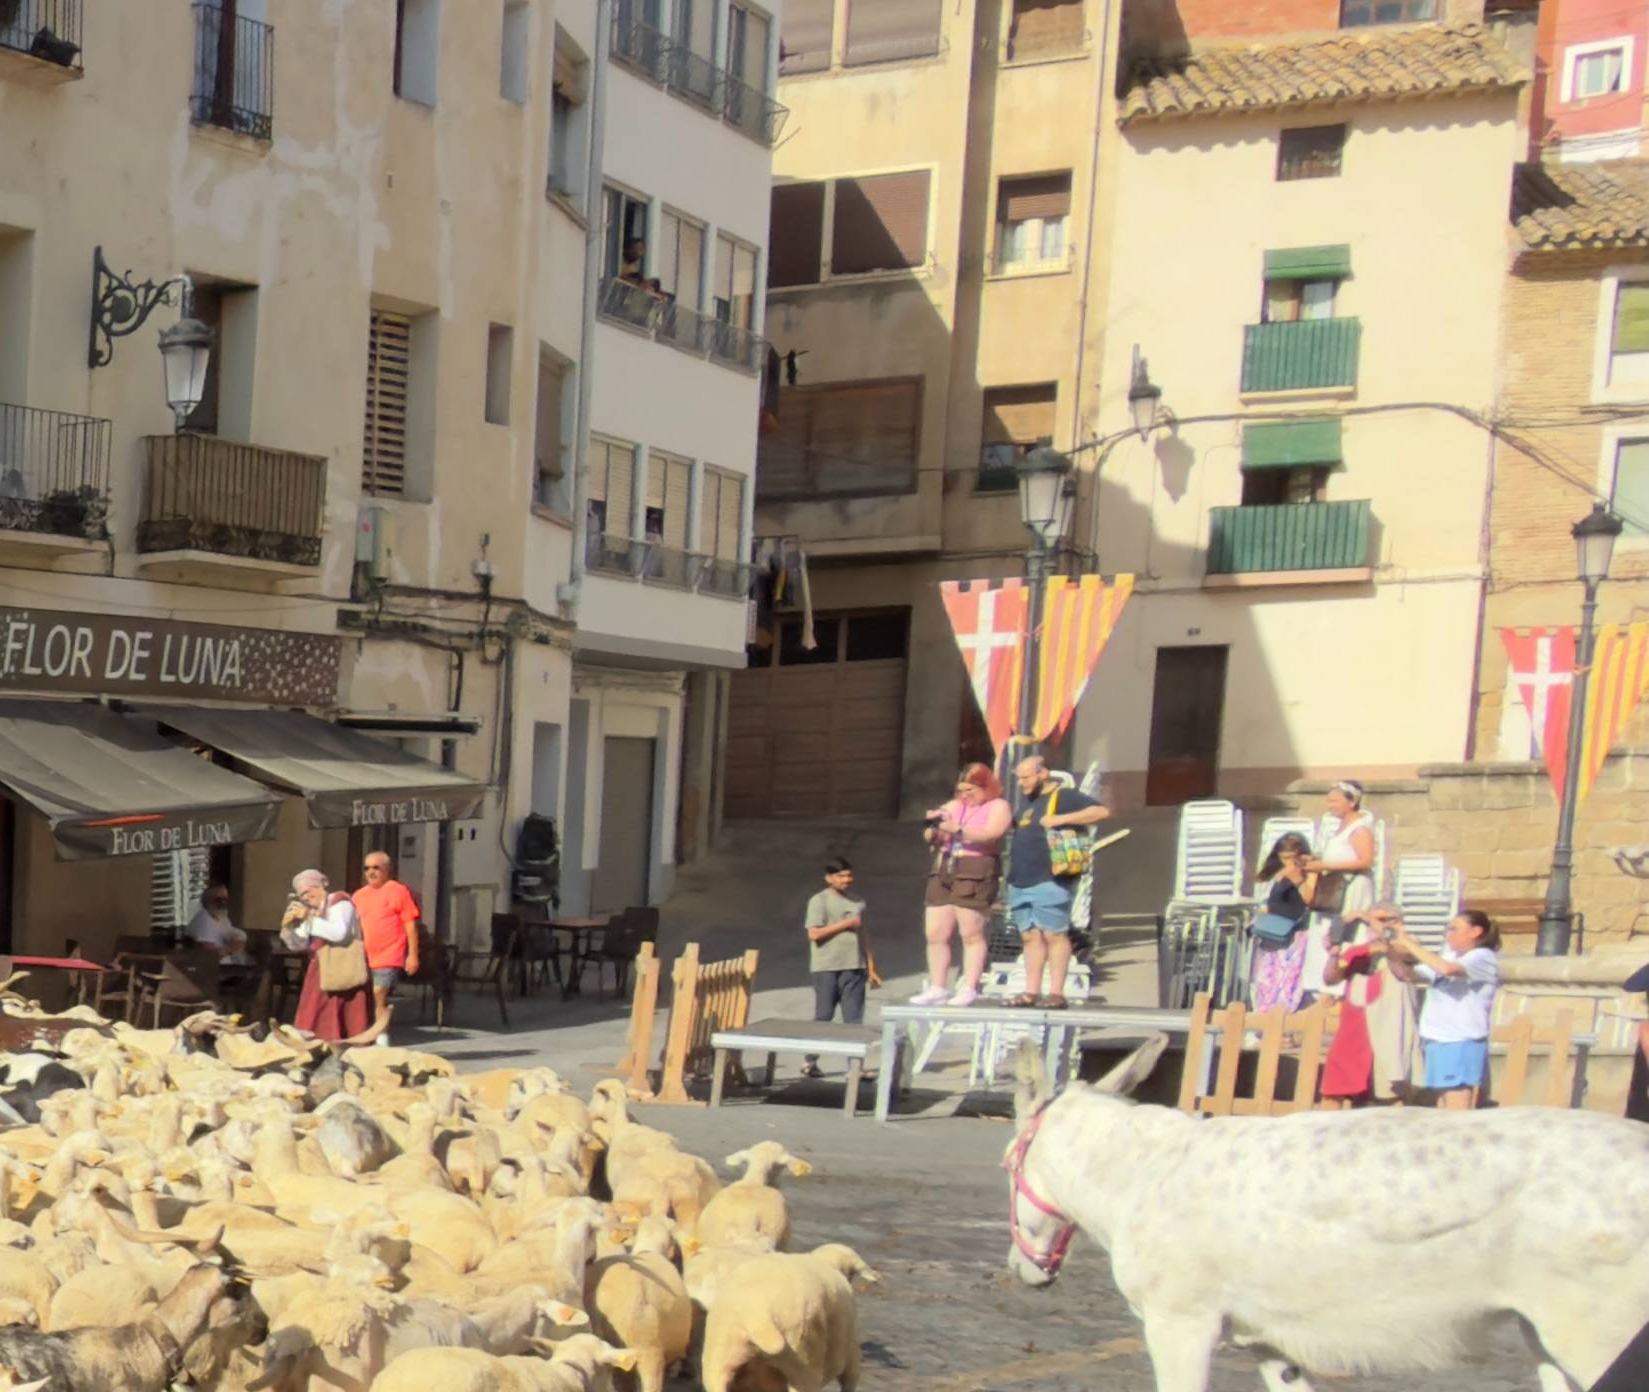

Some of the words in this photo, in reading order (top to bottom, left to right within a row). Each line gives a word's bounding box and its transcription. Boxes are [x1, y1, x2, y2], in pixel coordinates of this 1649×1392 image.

[3, 622, 94, 678] FLOR
[104, 629, 153, 681] DE
[160, 634, 242, 688] LUNA
[352, 801, 386, 825] FLOR
[390, 803, 408, 822] DE
[412, 798, 449, 821] LUNA
[112, 827, 153, 854] FLOR
[161, 828, 182, 848] DE
[187, 820, 233, 847] LUNA
